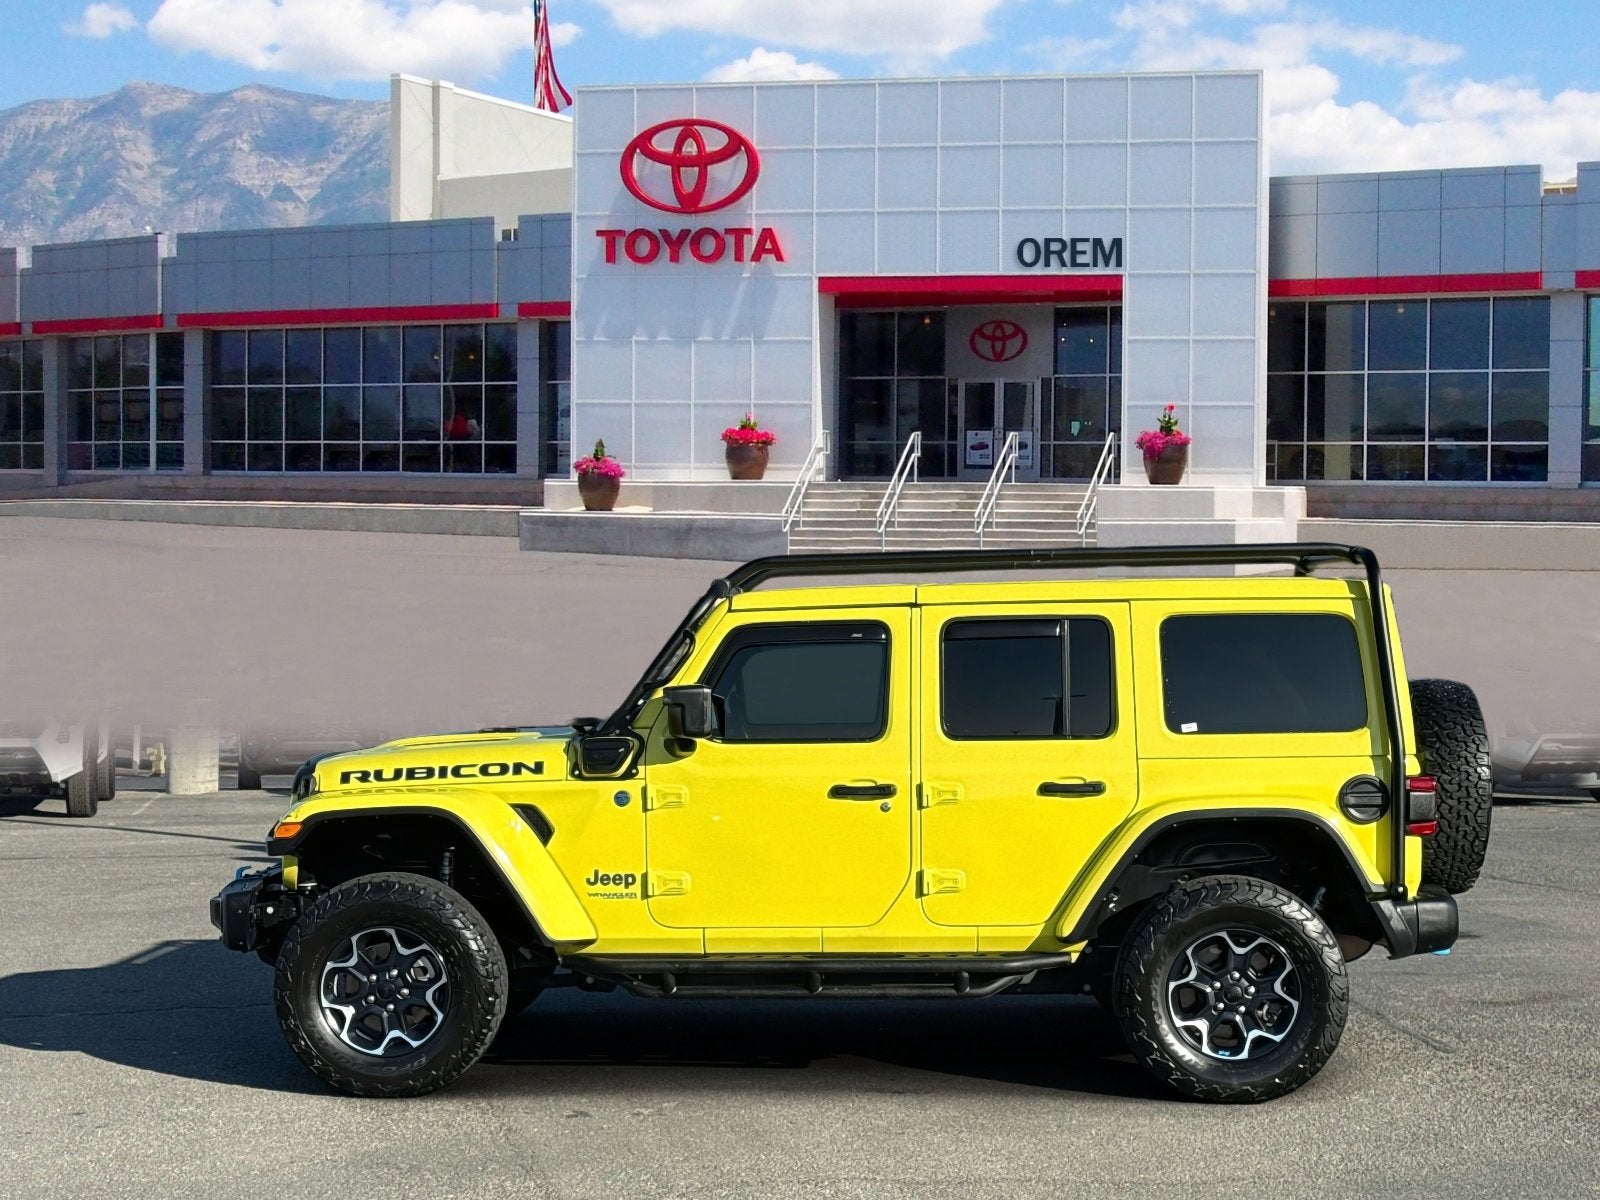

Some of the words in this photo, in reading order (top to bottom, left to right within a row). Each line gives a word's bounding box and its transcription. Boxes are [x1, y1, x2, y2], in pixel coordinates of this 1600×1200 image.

[596, 227, 784, 264] TOYOTA
[1017, 237, 1123, 268] OREM
[339, 760, 545, 785] RUBICON
[585, 869, 637, 889] Jeep
